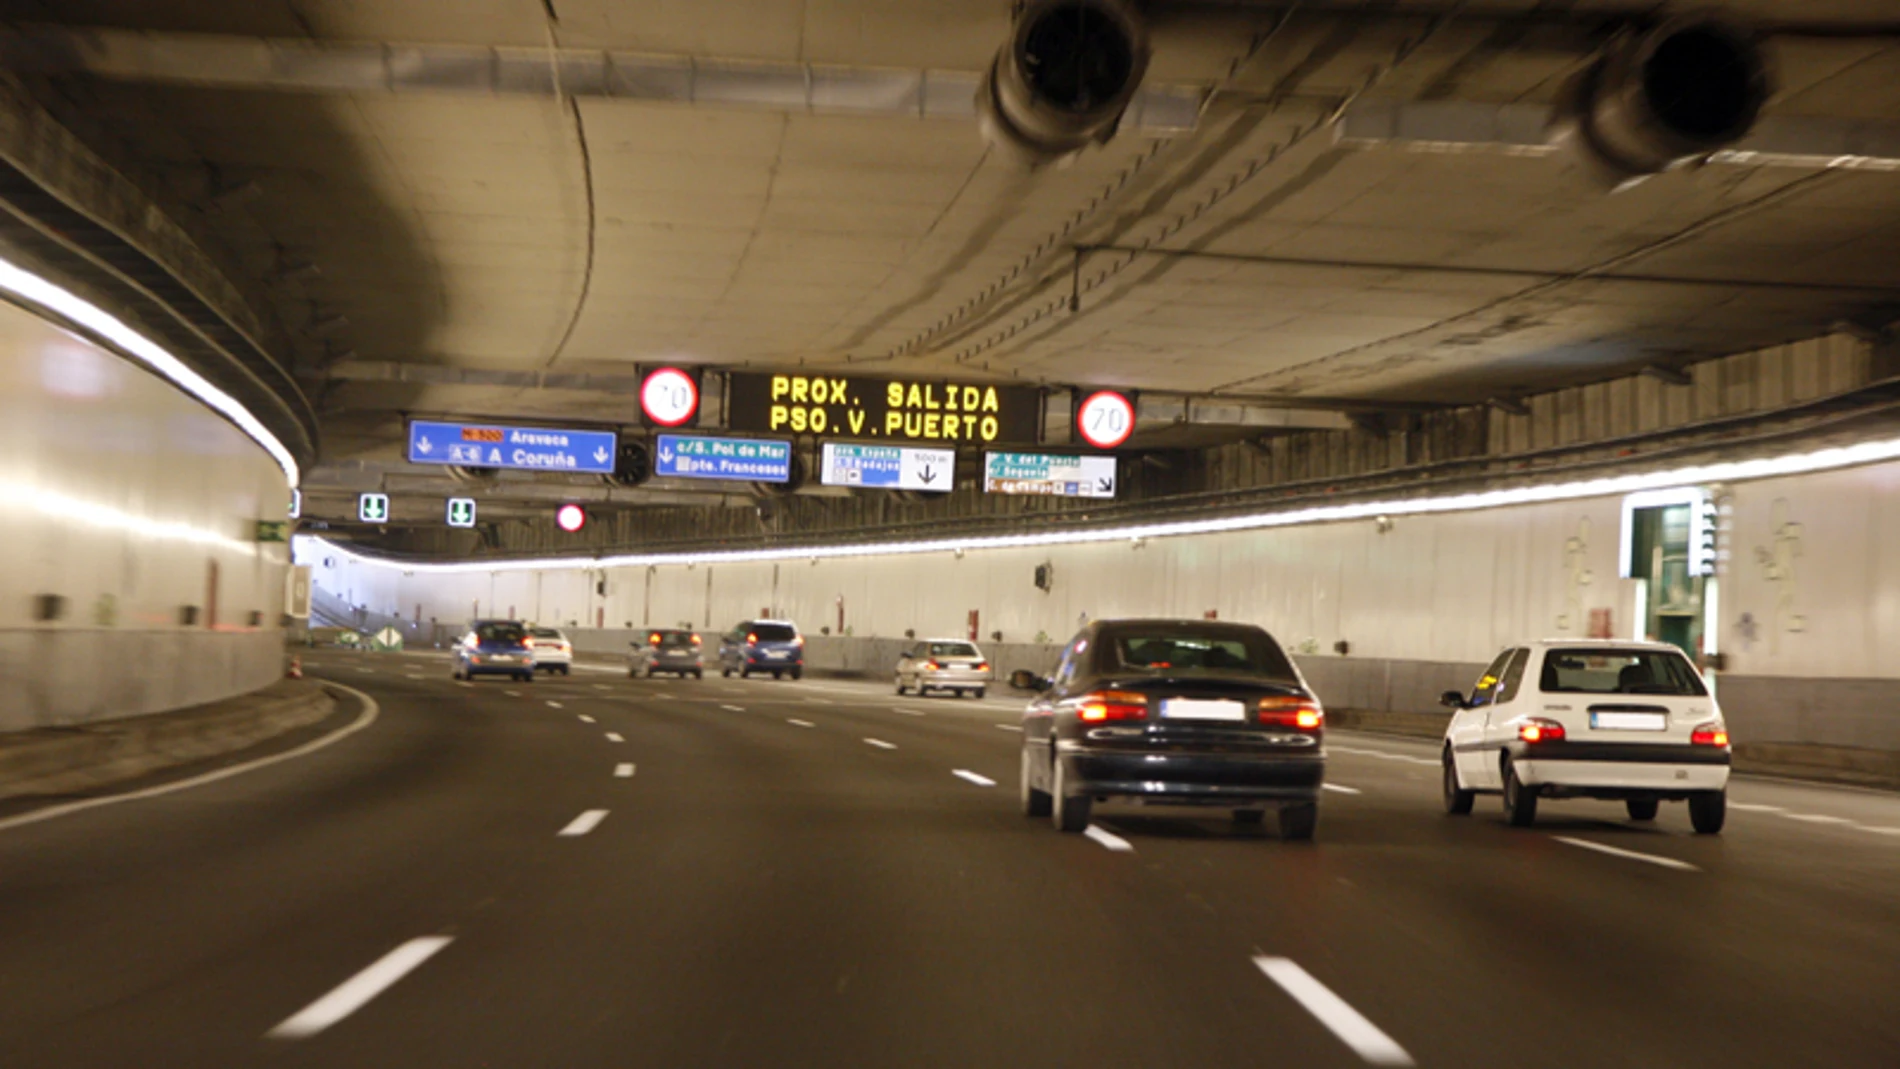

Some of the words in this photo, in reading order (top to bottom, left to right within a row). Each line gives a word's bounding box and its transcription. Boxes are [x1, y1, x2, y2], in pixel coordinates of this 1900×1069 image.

[652, 384, 687, 409] 70
[771, 376, 860, 406] PROX.
[887, 382, 999, 412] SALIDA
[1091, 407, 1124, 433] 70
[510, 430, 569, 447] Aravaca
[489, 448, 502, 463] A
[512, 449, 577, 468] Coruña
[712, 442, 736, 456] Pol
[738, 445, 756, 458] de
[759, 445, 785, 459] Mar
